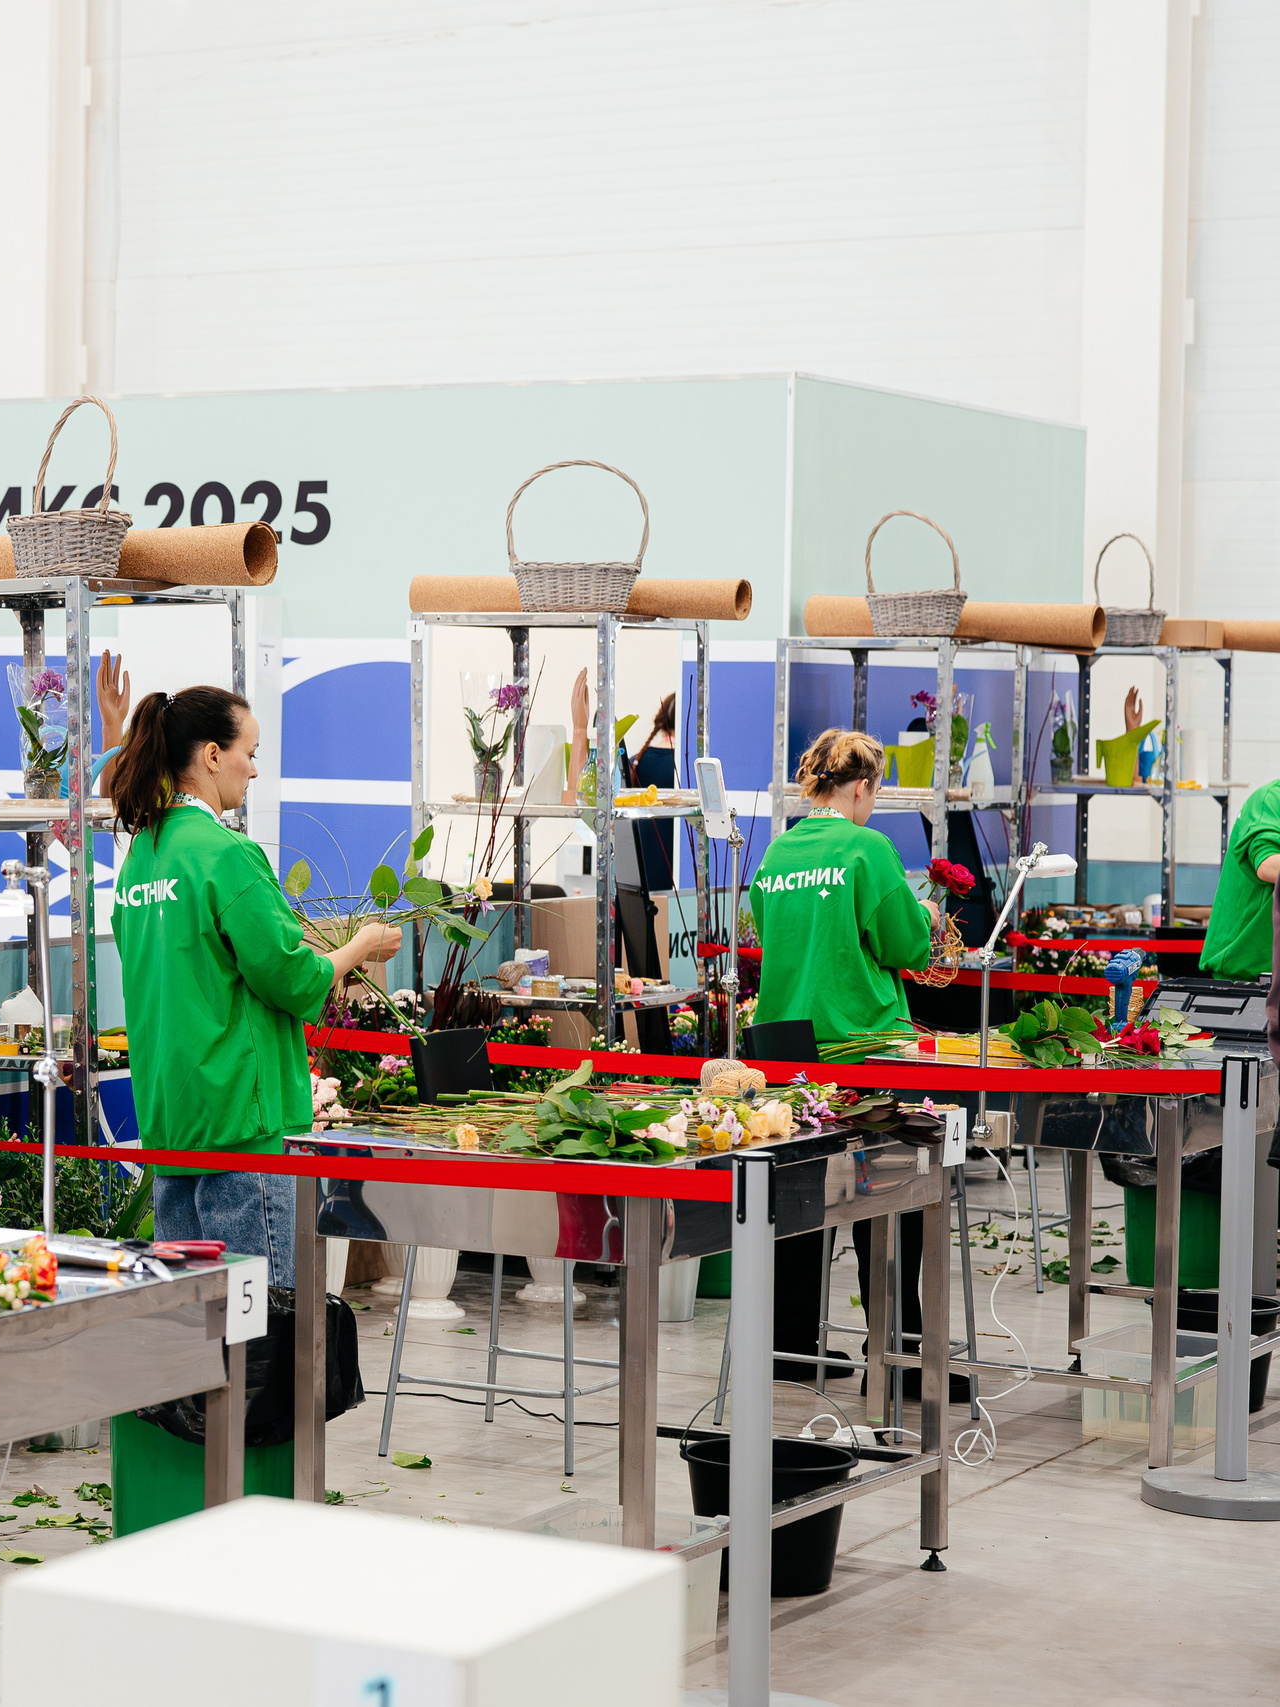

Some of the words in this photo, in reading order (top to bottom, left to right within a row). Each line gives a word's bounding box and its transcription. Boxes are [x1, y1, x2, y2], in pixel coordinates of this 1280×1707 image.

[144, 480, 331, 545] 2025
[952, 1121, 960, 1146] 4
[242, 1280, 253, 1315] 5
